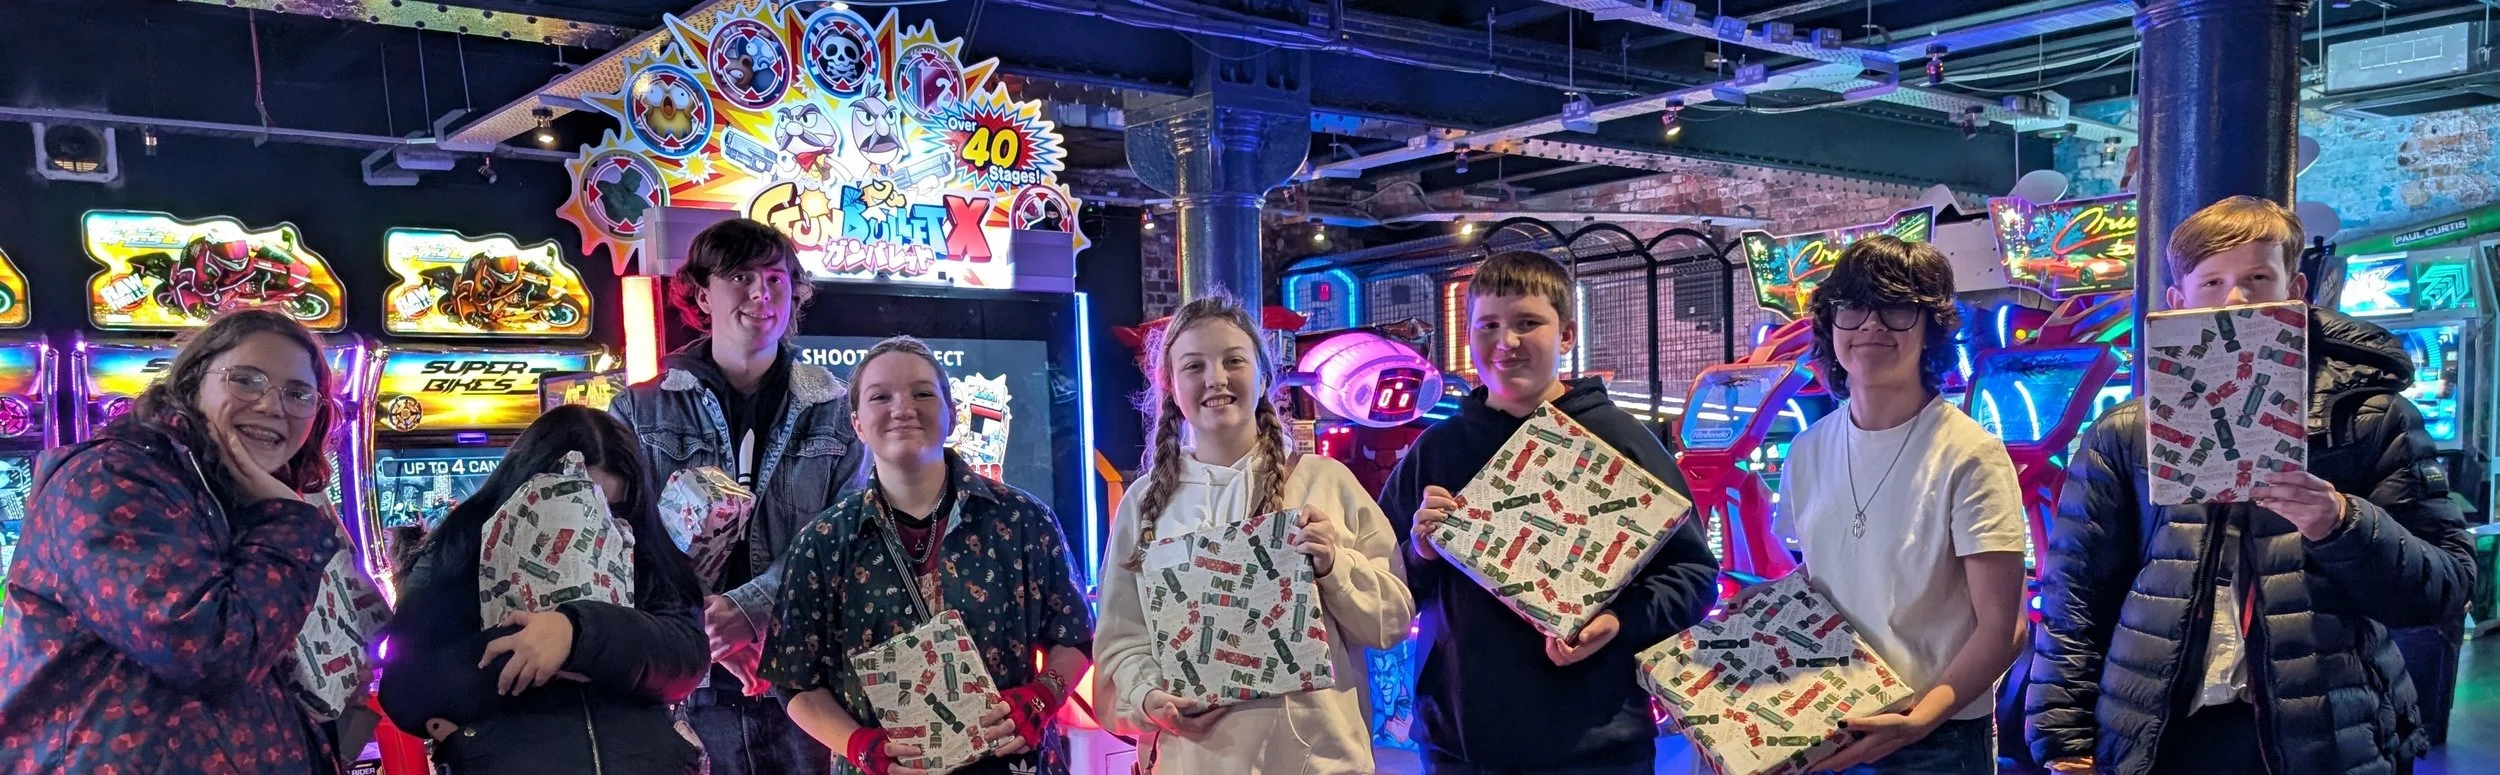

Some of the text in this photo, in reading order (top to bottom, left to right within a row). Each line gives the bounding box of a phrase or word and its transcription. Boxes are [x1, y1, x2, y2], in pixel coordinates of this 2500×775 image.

[948, 117, 977, 132] Over
[962, 127, 1018, 169] 40
[989, 165, 1040, 185] Stages!
[942, 195, 993, 263] X
[2394, 219, 2466, 244] PAUL CURTIS
[100, 273, 144, 303] RAW
[394, 284, 430, 312] RAW
[801, 348, 869, 366] SHOOT
[420, 360, 529, 376] SUPER
[421, 378, 518, 395] BIKES
[1692, 431, 1730, 440] Nintendo
[403, 460, 426, 475] UP
[430, 460, 449, 475] TO
[451, 458, 466, 475] 4
